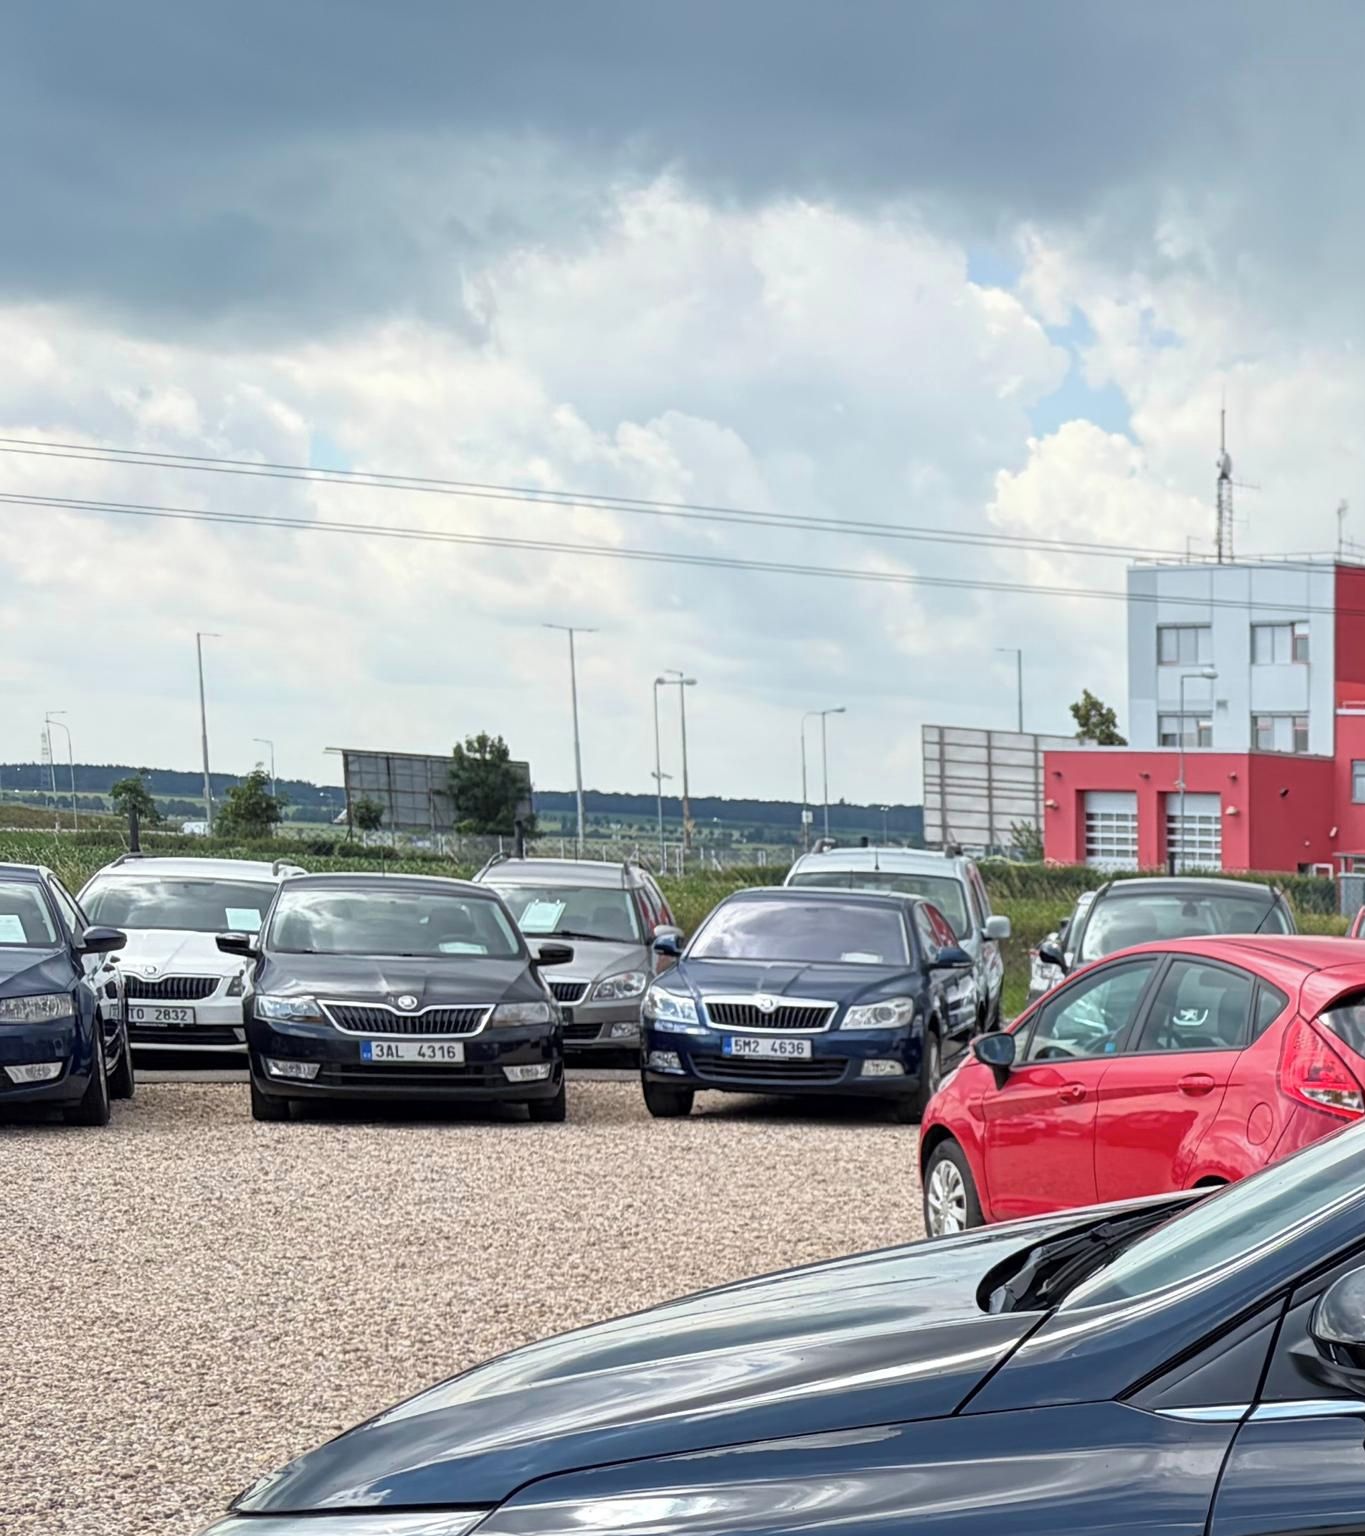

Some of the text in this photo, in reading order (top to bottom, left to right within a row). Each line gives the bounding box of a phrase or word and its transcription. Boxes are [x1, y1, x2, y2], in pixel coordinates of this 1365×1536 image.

[128, 1007, 188, 1021] TO 2832
[375, 1043, 456, 1060] 3AL 4316
[734, 1039, 805, 1055] 5M2 4636
